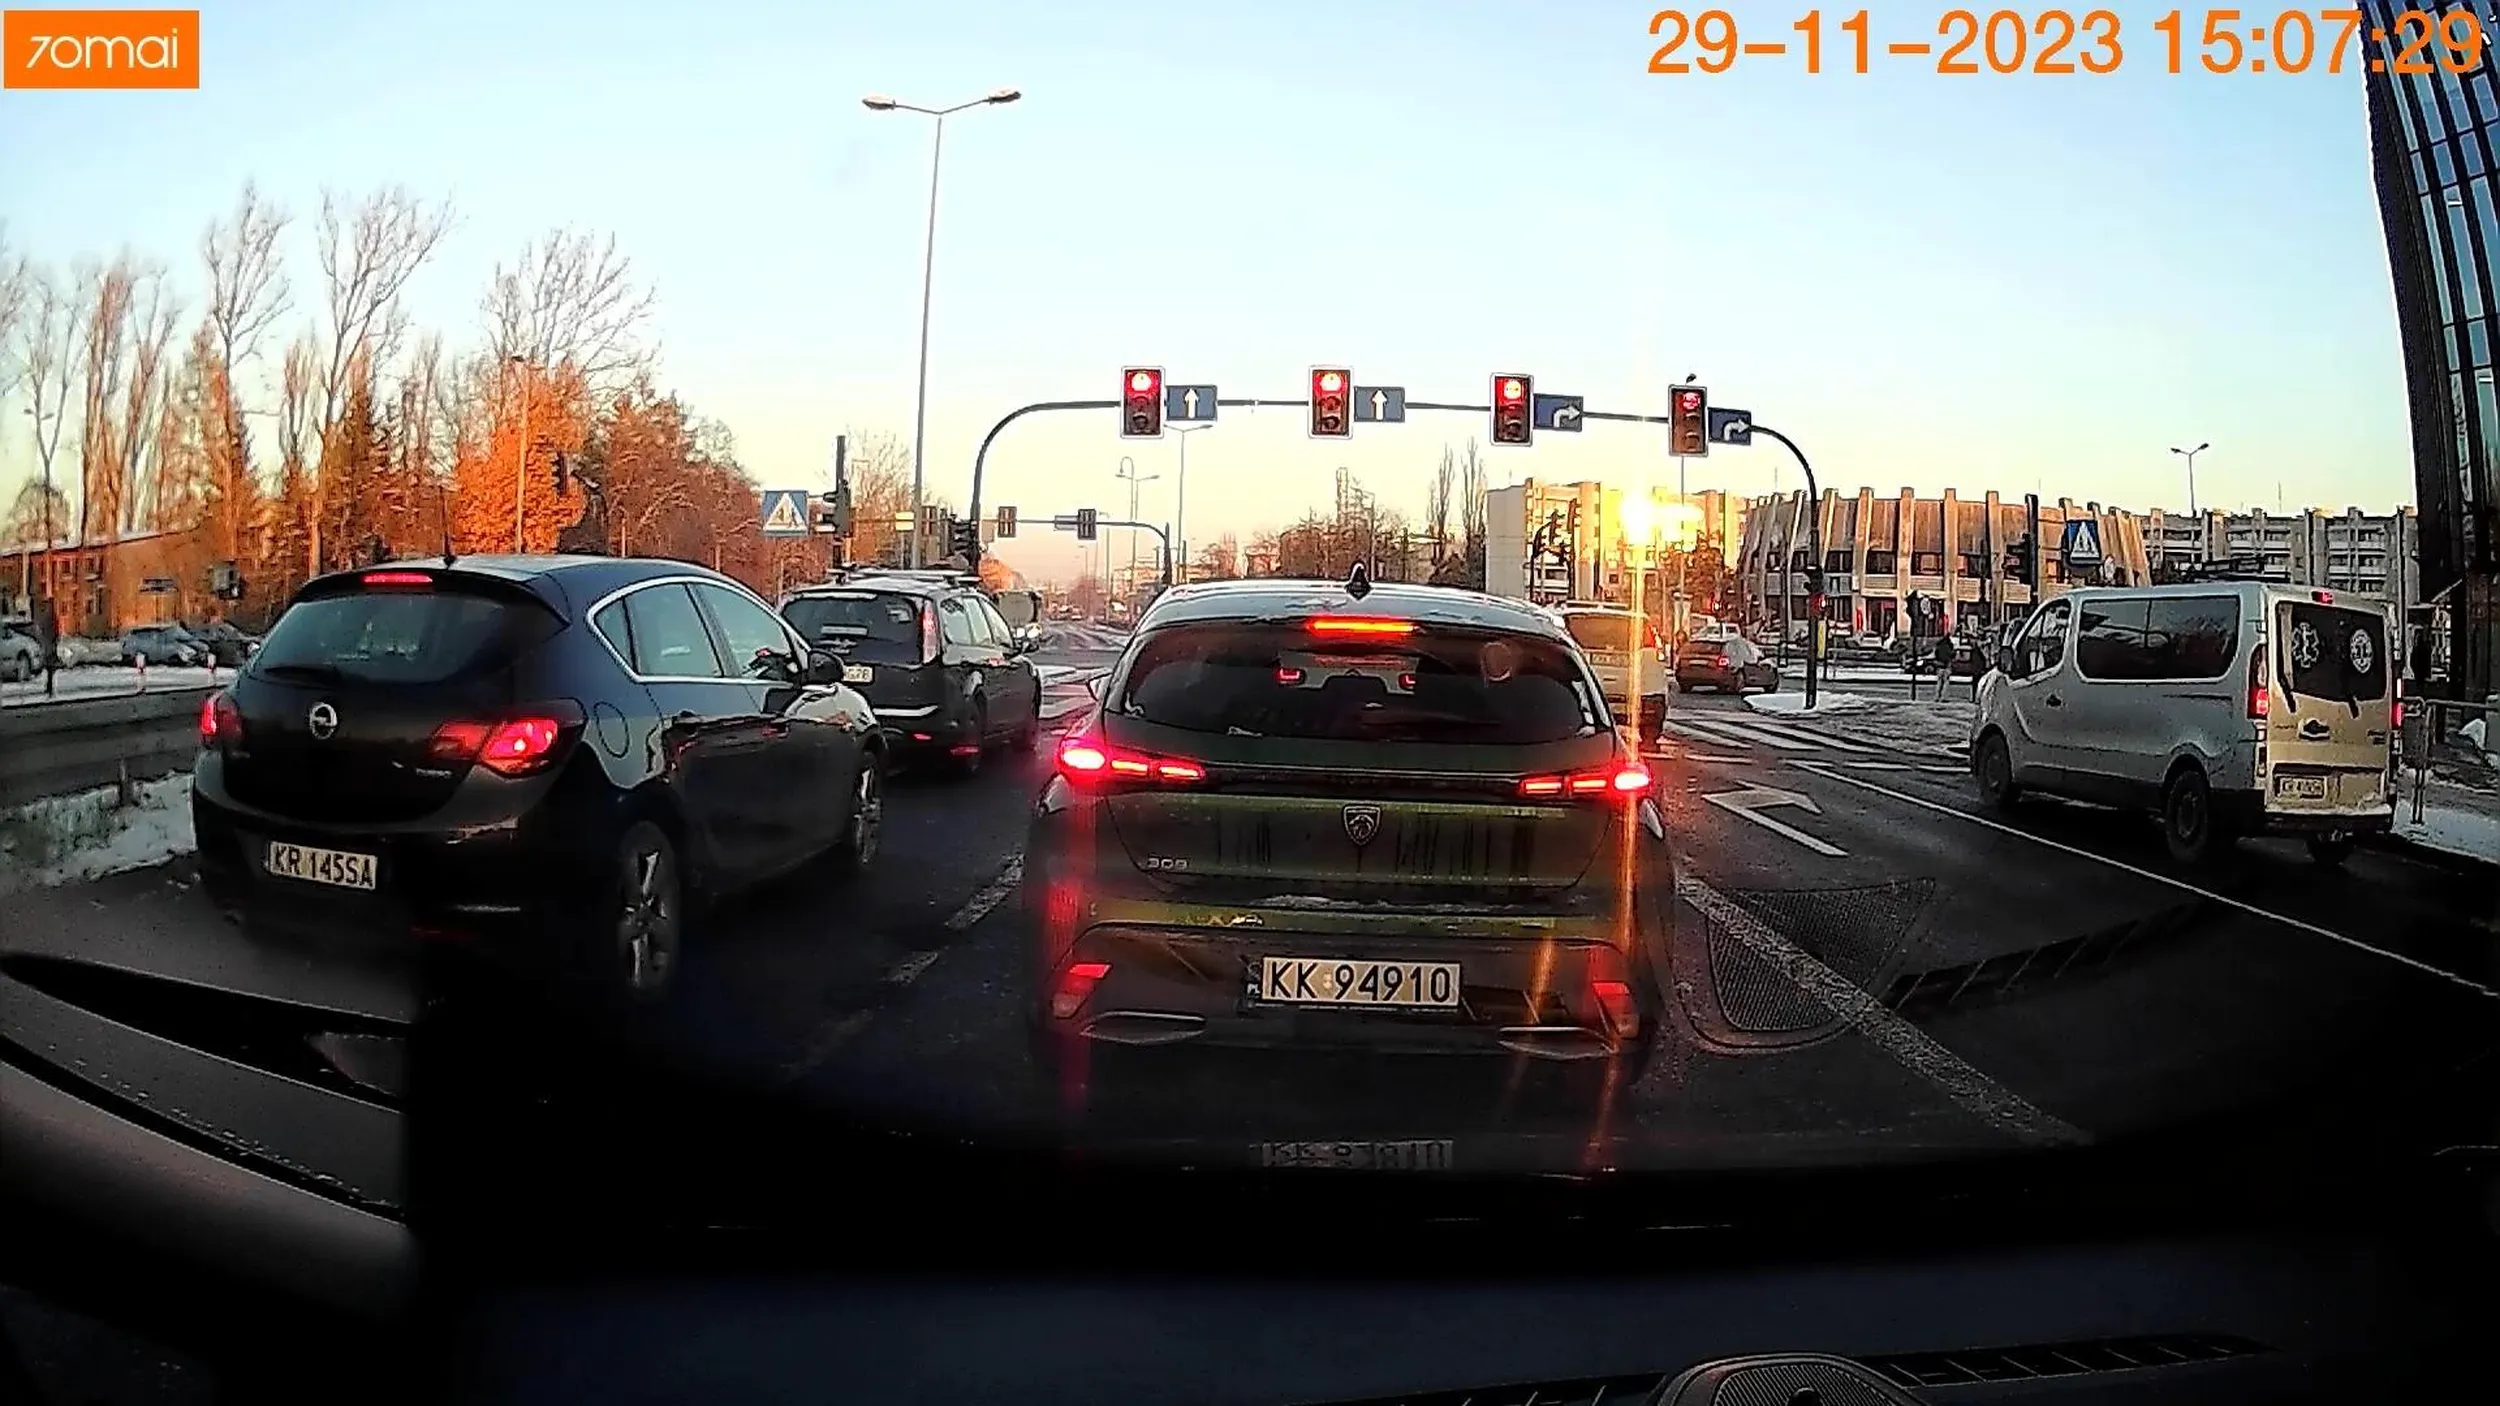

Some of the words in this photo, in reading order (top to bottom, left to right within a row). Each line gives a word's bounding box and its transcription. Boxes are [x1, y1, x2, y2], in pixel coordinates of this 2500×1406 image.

[274, 845, 301, 875] KR
[311, 852, 374, 888] 145SA
[1270, 961, 1318, 999] KK
[1334, 964, 1451, 1003] 94910
